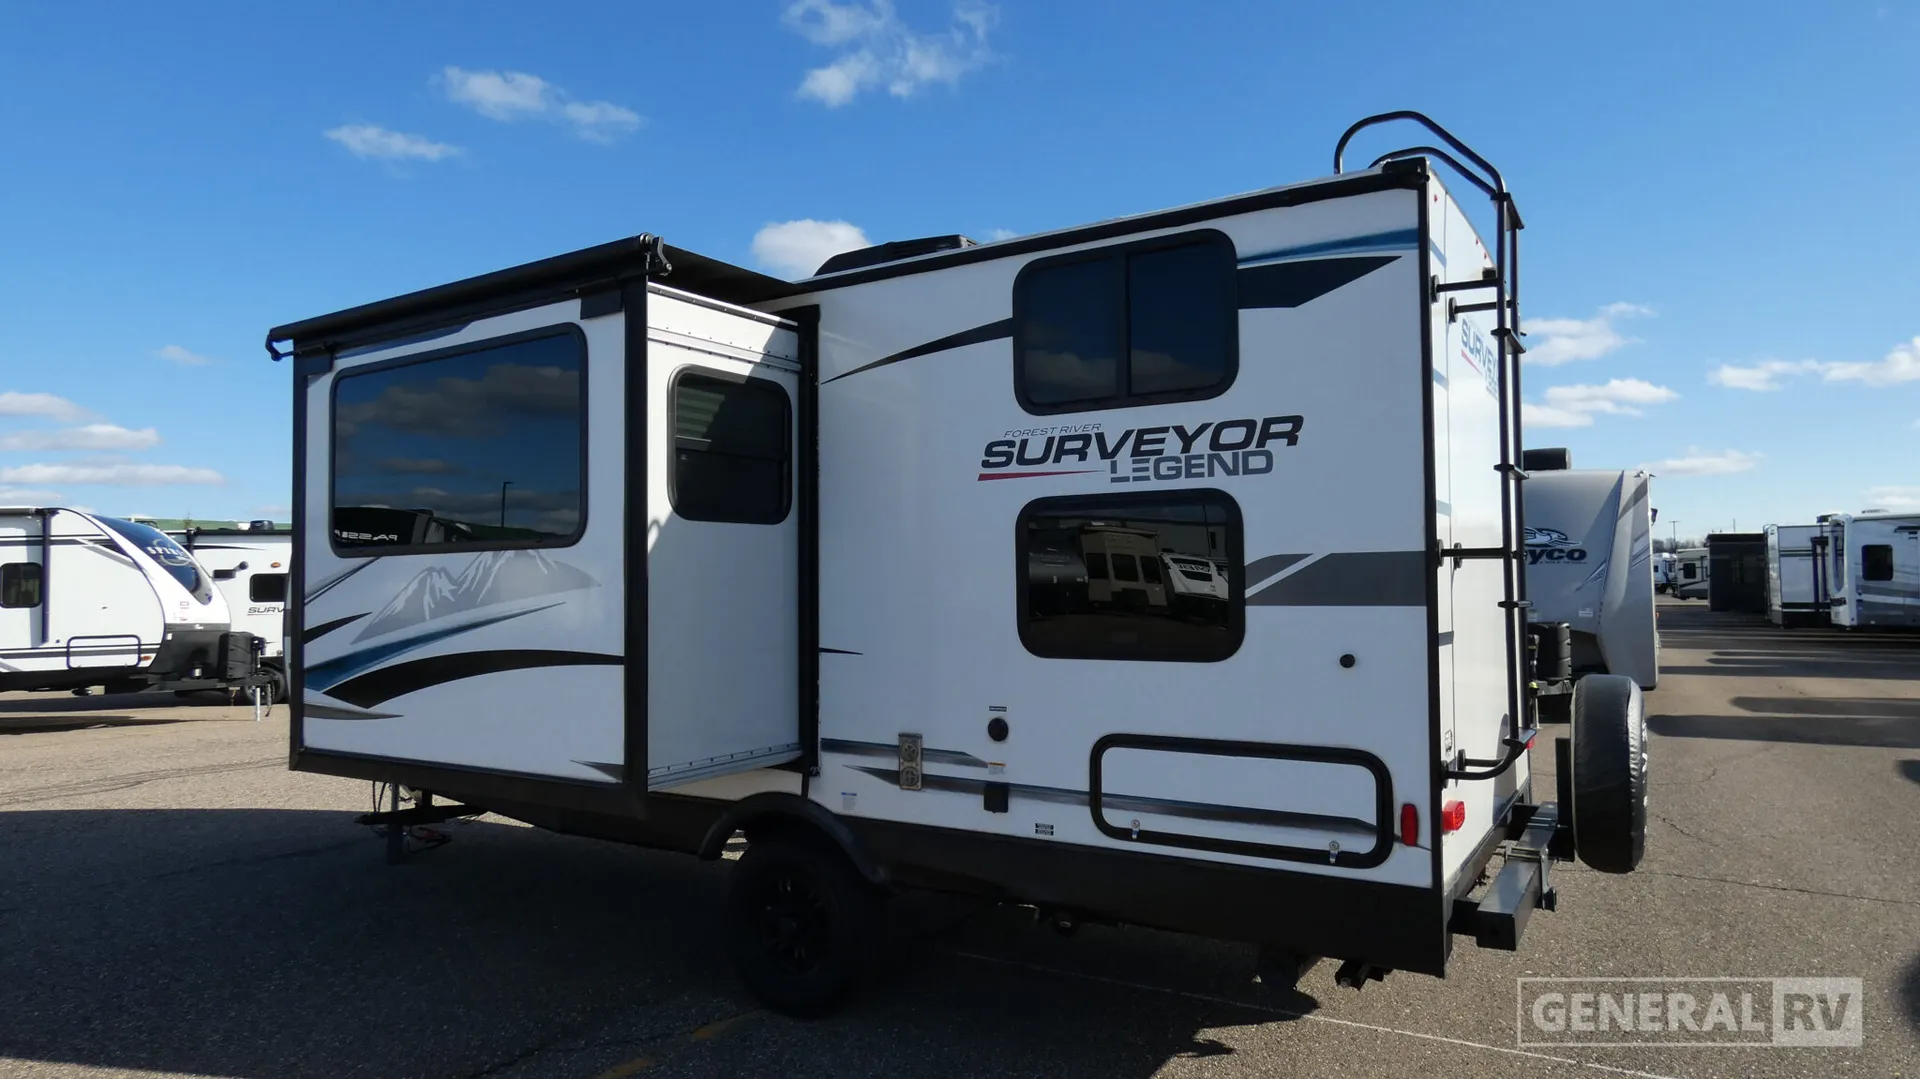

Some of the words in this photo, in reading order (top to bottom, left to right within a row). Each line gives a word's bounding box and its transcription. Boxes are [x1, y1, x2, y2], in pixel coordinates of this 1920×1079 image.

[981, 415, 1304, 468] SURVEYOR
[1004, 427, 1057, 438] FOREST
[1059, 423, 1102, 434] RIVER
[1110, 450, 1273, 483] LEGEND
[1524, 548, 1587, 565] yco
